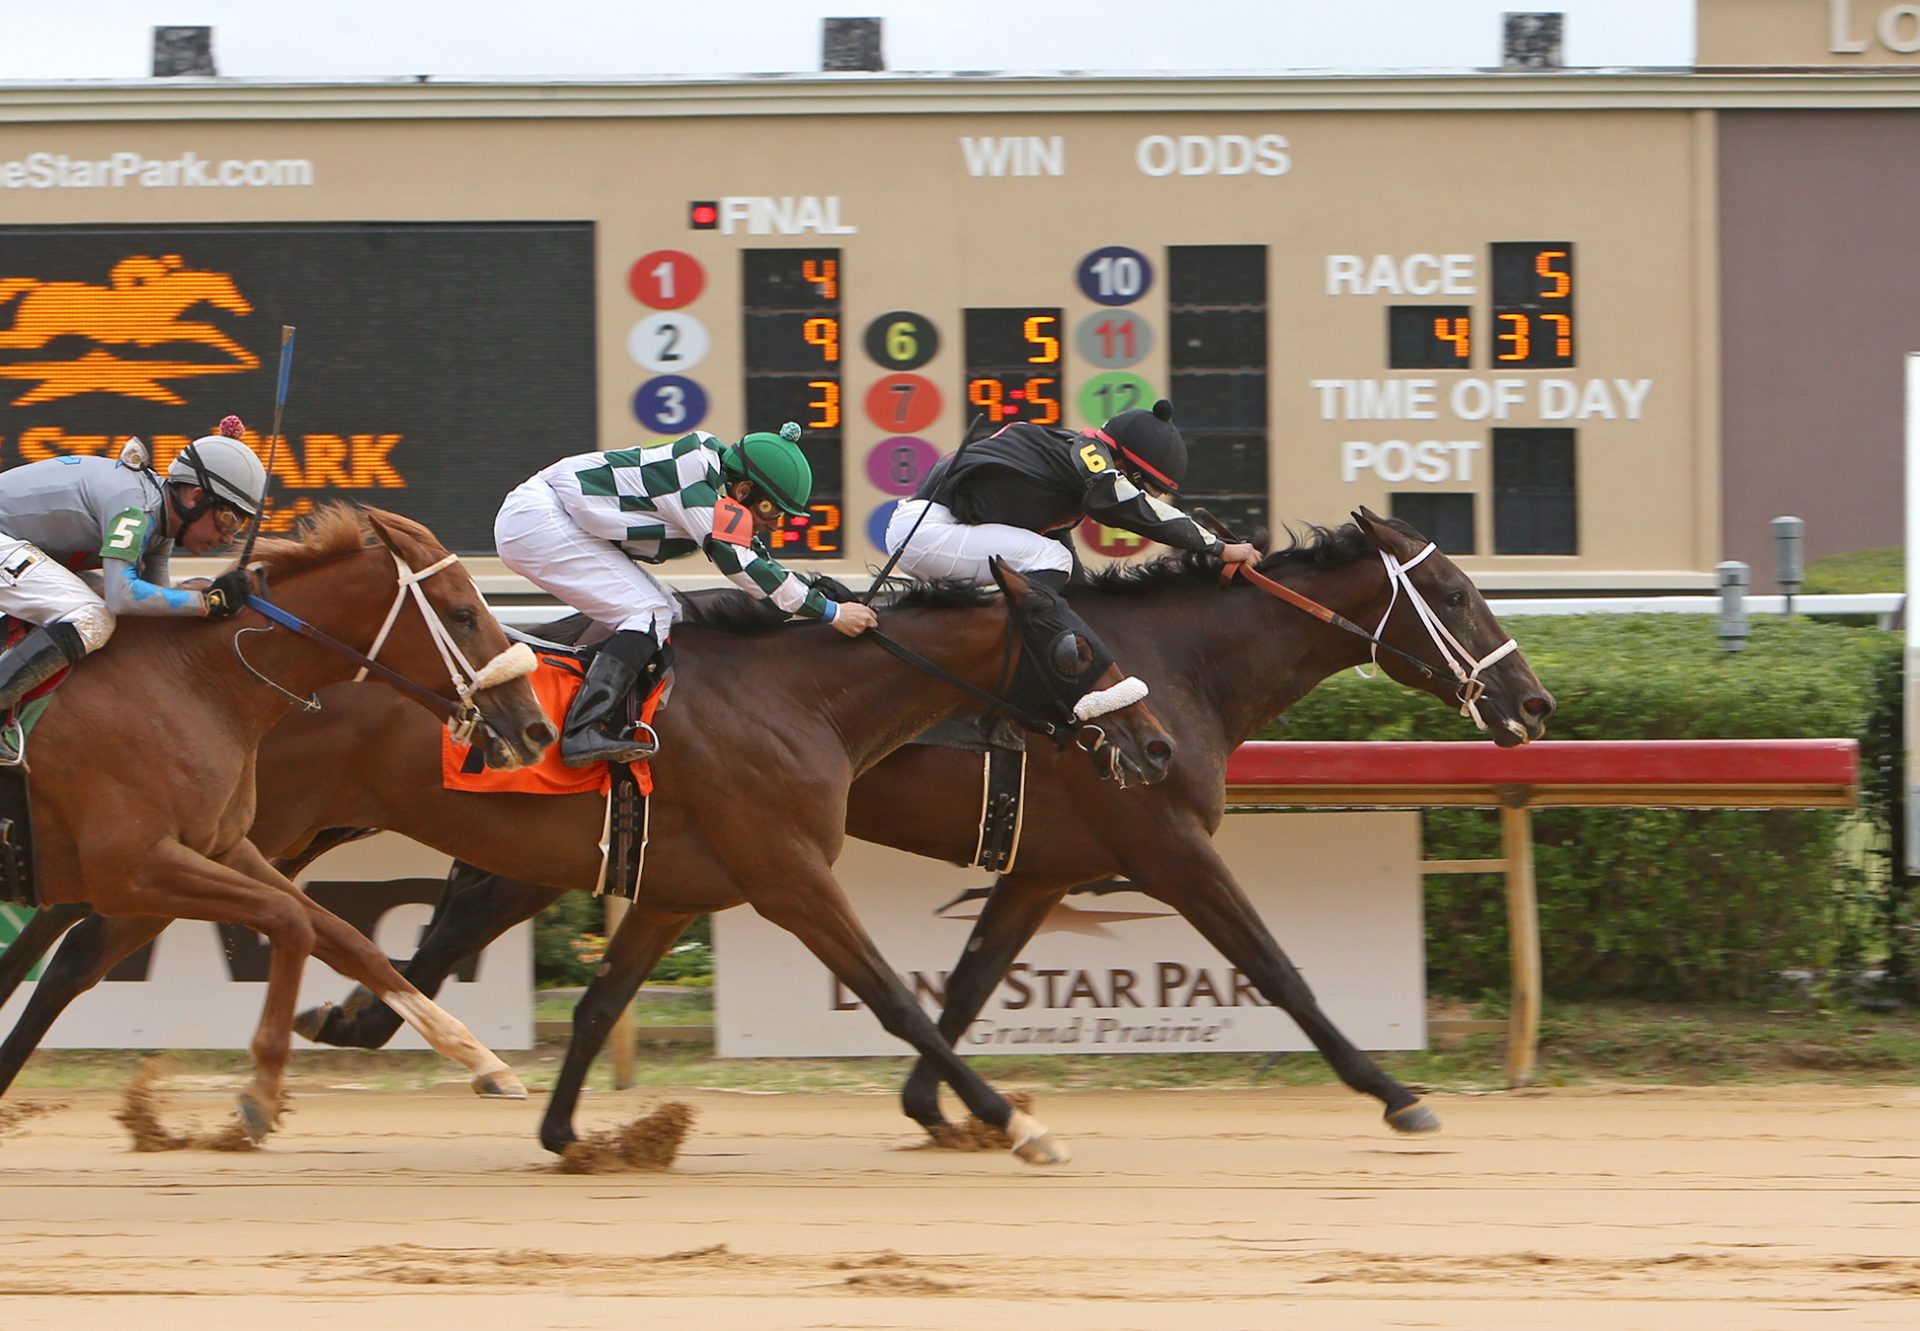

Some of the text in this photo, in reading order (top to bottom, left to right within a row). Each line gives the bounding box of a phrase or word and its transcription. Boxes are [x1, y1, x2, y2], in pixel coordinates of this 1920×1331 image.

[962, 135, 1291, 176] WIN ODDS
[720, 196, 858, 234] FINAL
[652, 261, 676, 298] 1
[802, 259, 837, 299] 4
[1090, 256, 1142, 296] 10
[1326, 253, 1476, 296] RACE
[1535, 251, 1571, 299] 5
[656, 323, 681, 361] 2
[803, 318, 839, 361] 9
[886, 321, 918, 361] 6
[1023, 316, 1060, 364] 5
[1094, 319, 1137, 359] 11
[1434, 313, 1572, 361] 4 37
[655, 385, 687, 425] 3
[807, 381, 840, 429] 3
[889, 384, 917, 424] 7
[1310, 379, 1653, 420] TIME OF DAY
[891, 447, 917, 485] 8
[1079, 443, 1107, 473] 6
[1341, 440, 1481, 482] POST
[109, 517, 142, 549] 5
[723, 505, 743, 534] 7
[1002, 962, 1142, 1009] STAR
[1154, 962, 1303, 1008] PAR
[964, 1018, 1083, 1045] Grand
